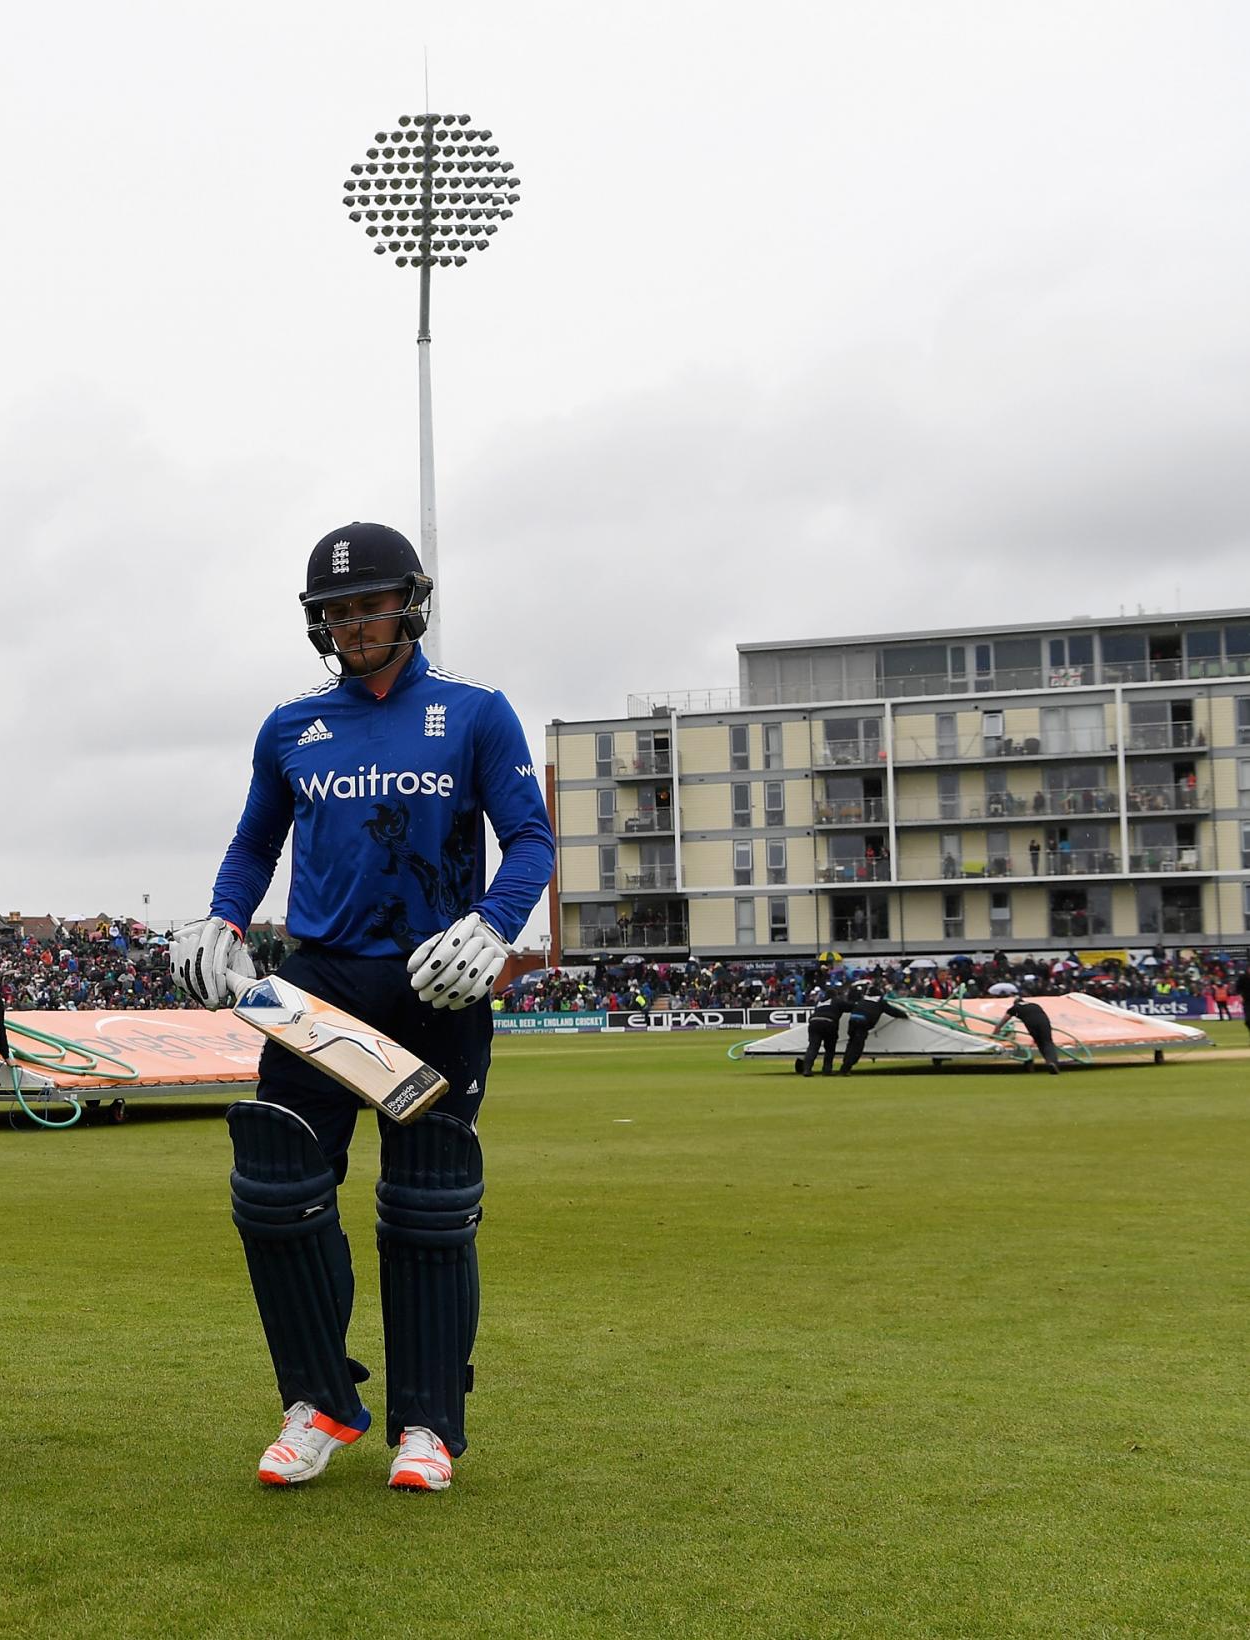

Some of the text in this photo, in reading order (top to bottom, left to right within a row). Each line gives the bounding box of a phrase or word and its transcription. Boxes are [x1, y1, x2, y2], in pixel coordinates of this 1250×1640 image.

[297, 731, 334, 746] adidas
[298, 763, 454, 804] Waitrose
[519, 1019, 536, 1028] BEER
[543, 1017, 574, 1027] ENGLAND
[575, 1016, 603, 1026] CRICKET
[627, 1012, 724, 1027] ETIHAD
[769, 1010, 815, 1024] ETI
[386, 1084, 415, 1109] Riverside
[392, 1090, 420, 1113] CAPITAL
